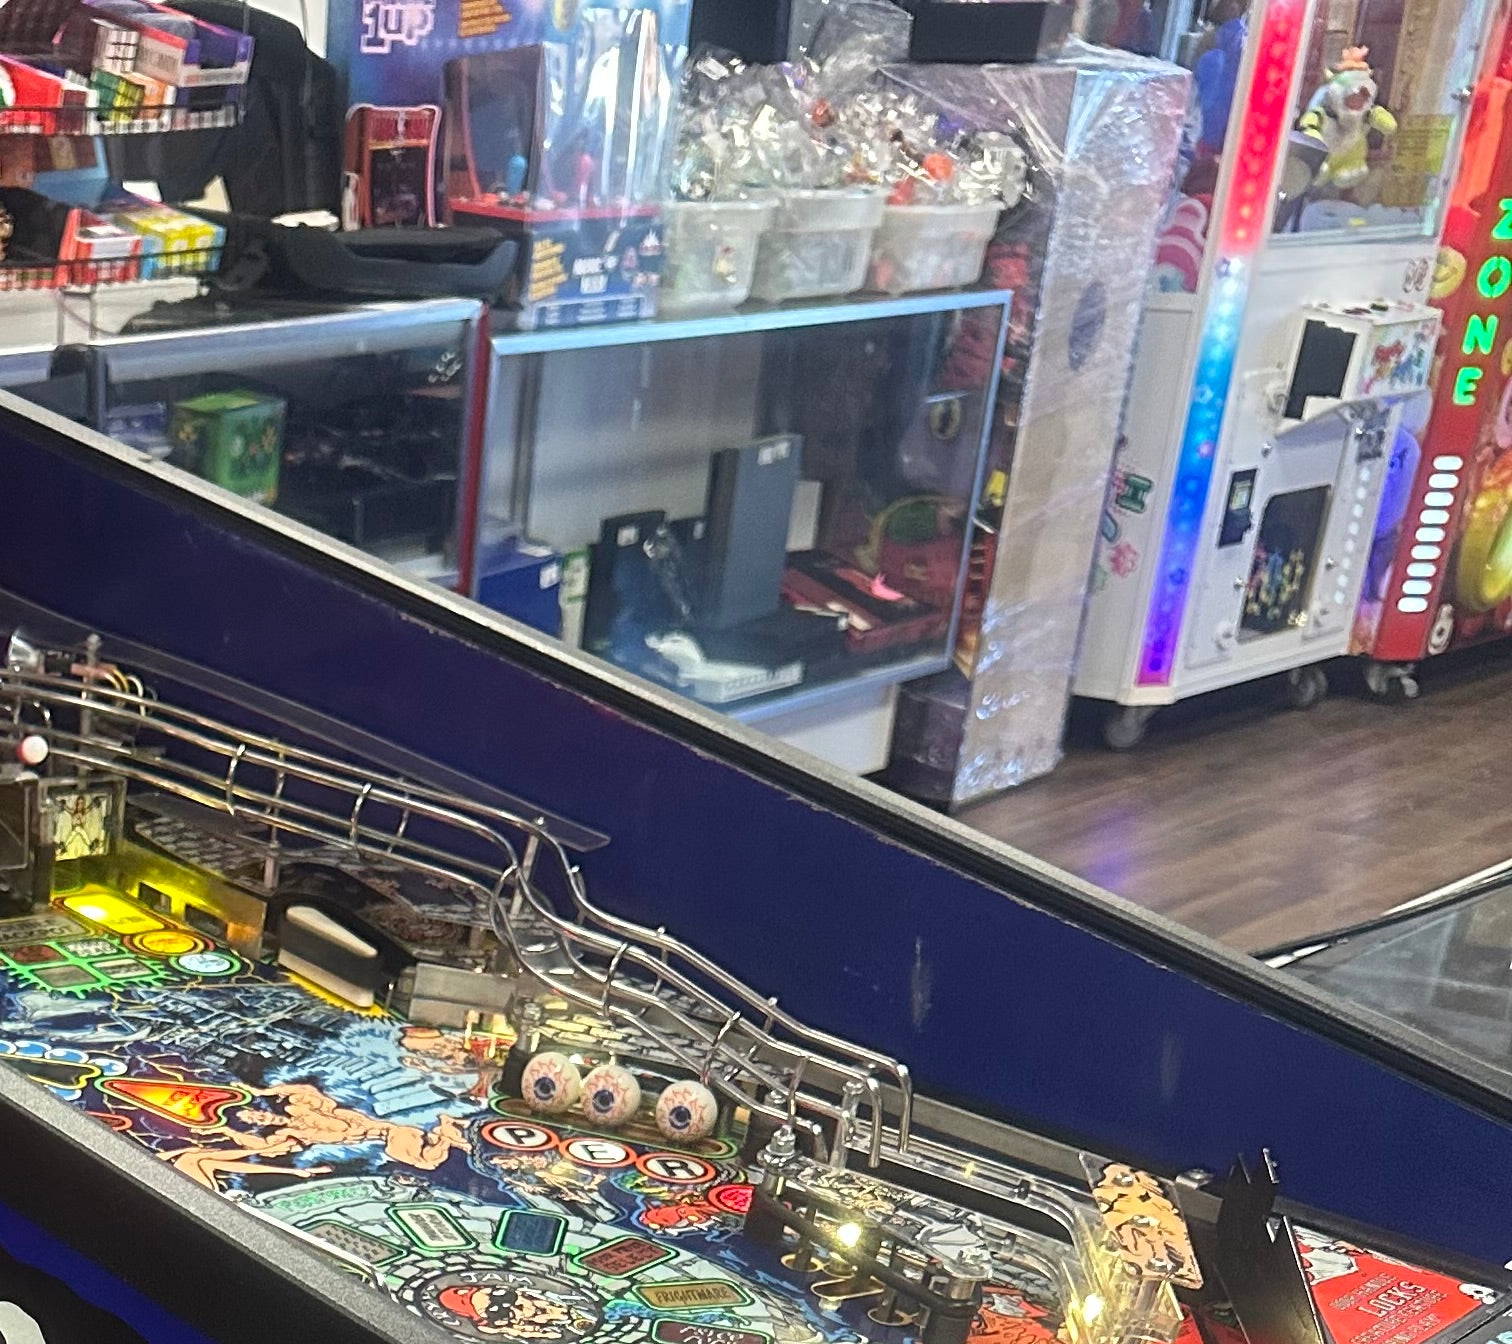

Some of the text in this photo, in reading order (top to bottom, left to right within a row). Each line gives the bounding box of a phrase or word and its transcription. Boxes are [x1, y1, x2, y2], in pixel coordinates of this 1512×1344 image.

[1453, 198, 1512, 406] ZONE
[459, 1272, 533, 1287] JAM
[655, 1285, 734, 1304] FRIGHTMARE
[1356, 1279, 1428, 1319] LOCKS
